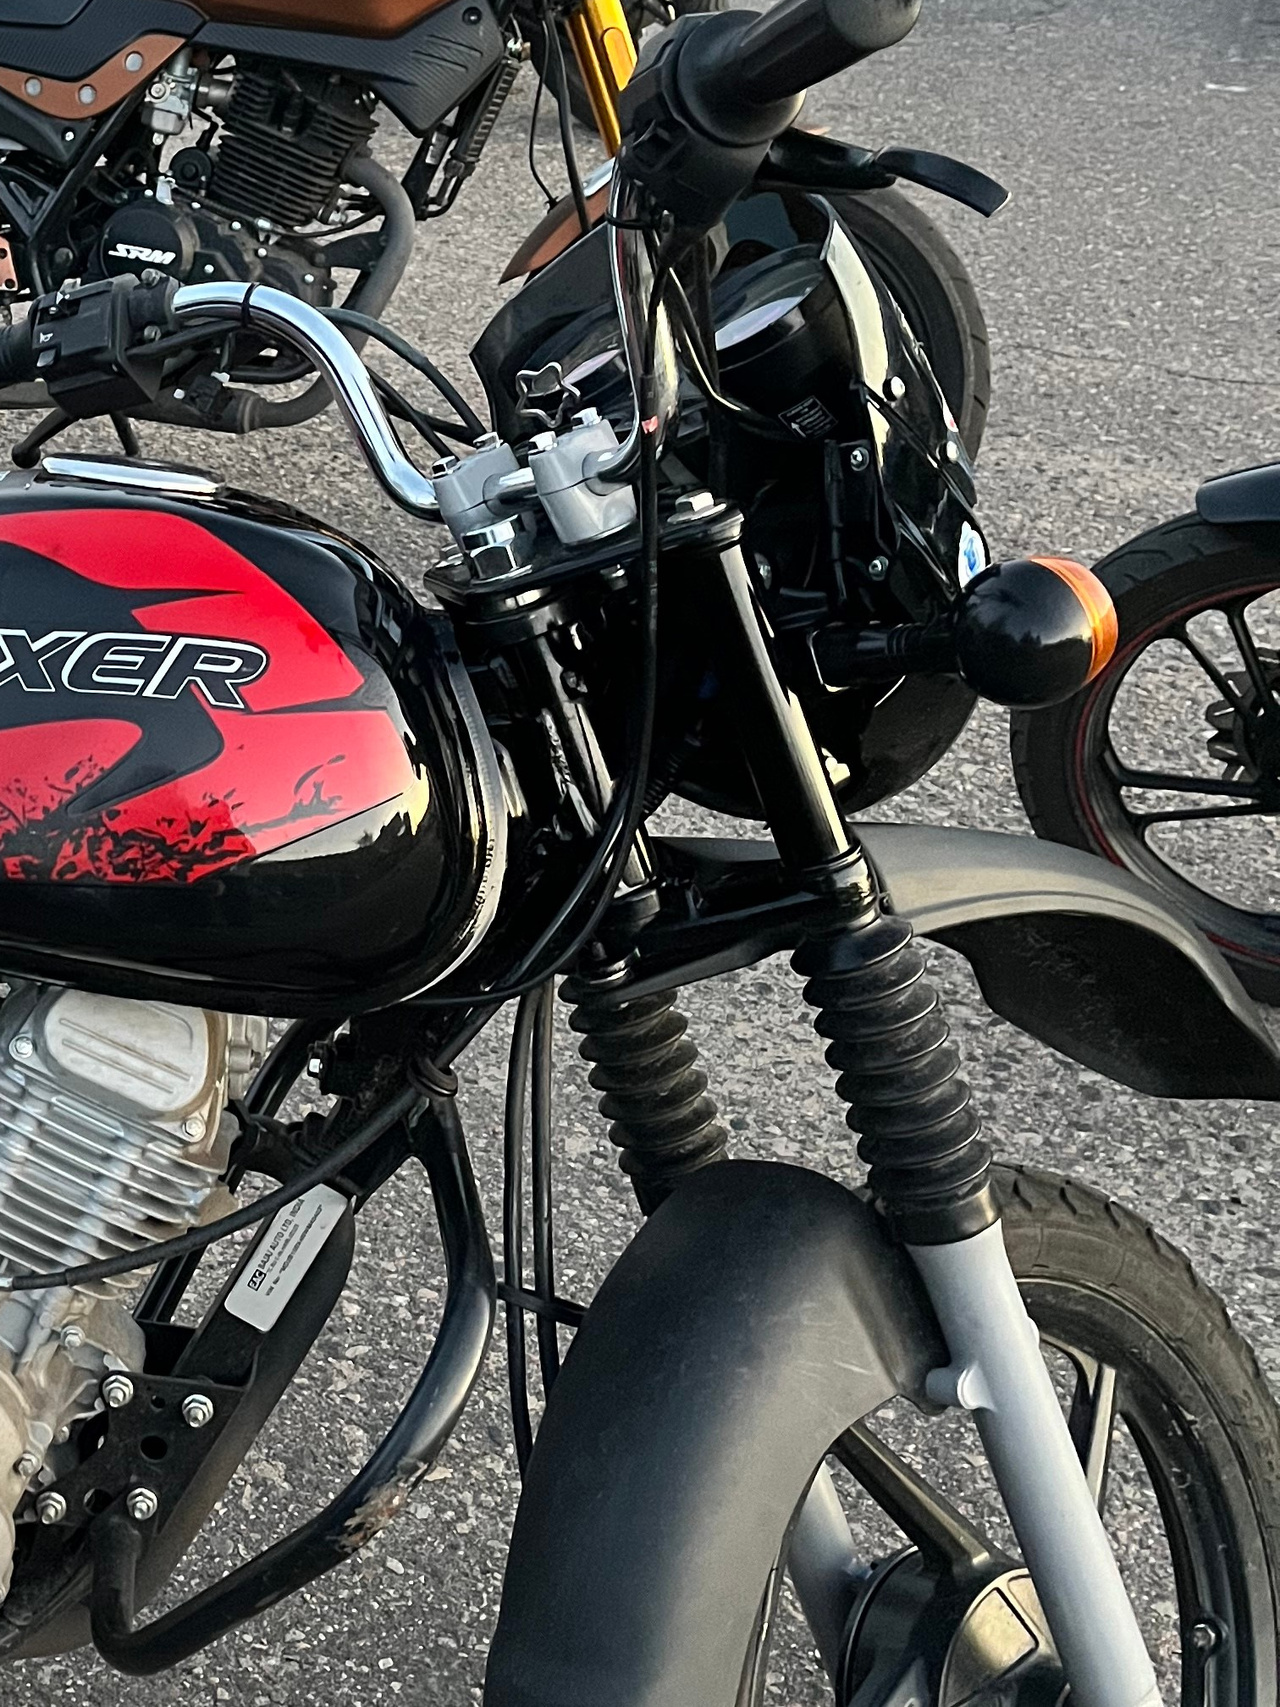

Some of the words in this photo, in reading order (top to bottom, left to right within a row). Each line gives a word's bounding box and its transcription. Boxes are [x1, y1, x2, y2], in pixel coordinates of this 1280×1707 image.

[108, 243, 176, 264] SRM
[270, 1231, 284, 1251] AUTO
[248, 1270, 266, 1290] EAC
